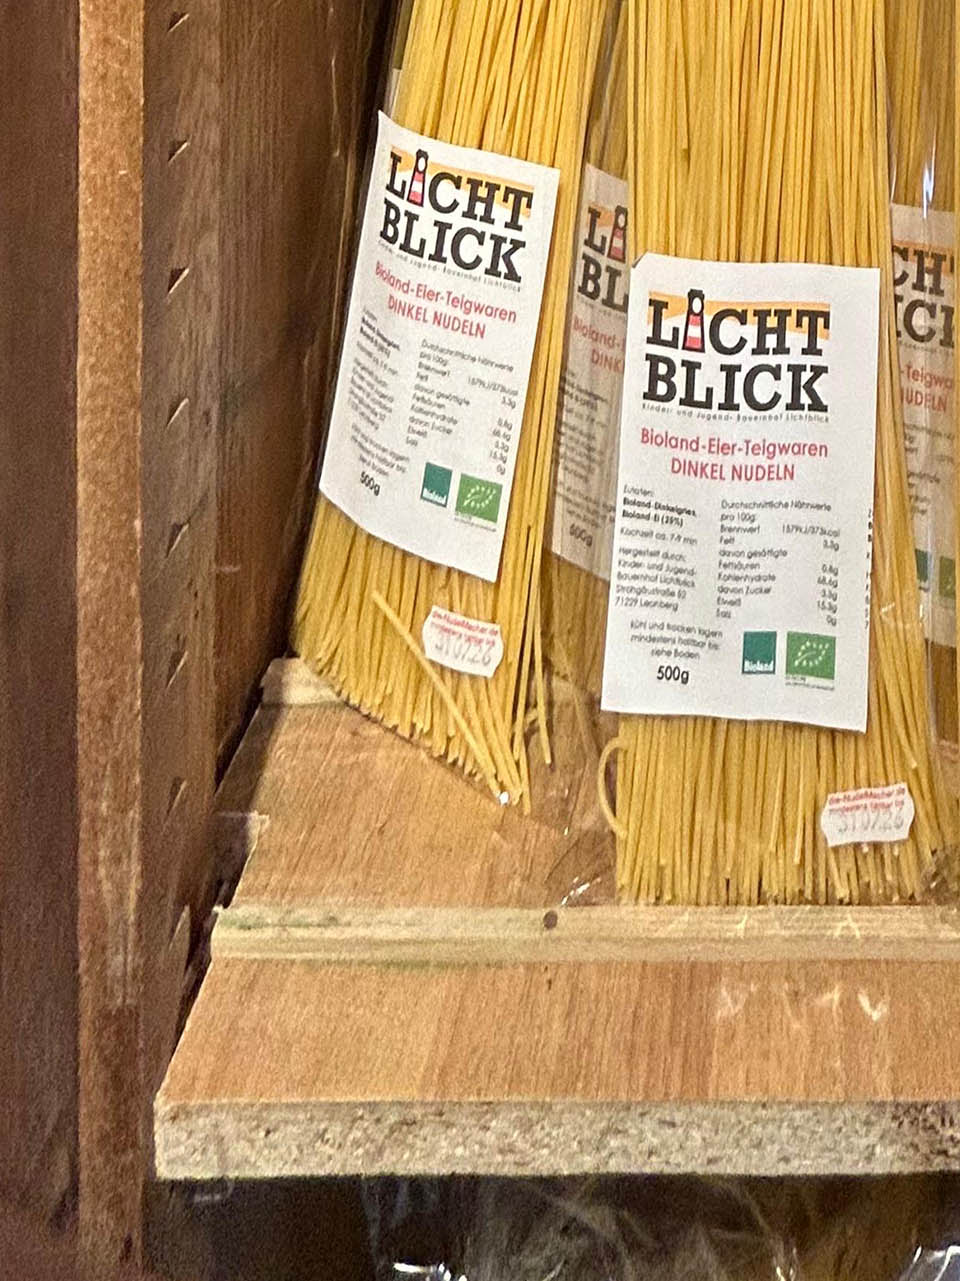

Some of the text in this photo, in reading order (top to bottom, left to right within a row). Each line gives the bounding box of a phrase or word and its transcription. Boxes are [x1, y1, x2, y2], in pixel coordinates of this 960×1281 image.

[379, 197, 527, 283] BLICK
[388, 294, 486, 339] DINKEL NUDELN
[592, 347, 625, 372] DINK
[642, 352, 829, 413] BLICK
[677, 409, 693, 418] und
[641, 427, 828, 460] Bioland-Eier-Teigwaren
[671, 457, 795, 481] DINKEL NUDELN
[360, 471, 380, 496] 500g
[656, 665, 690, 685] 500g
